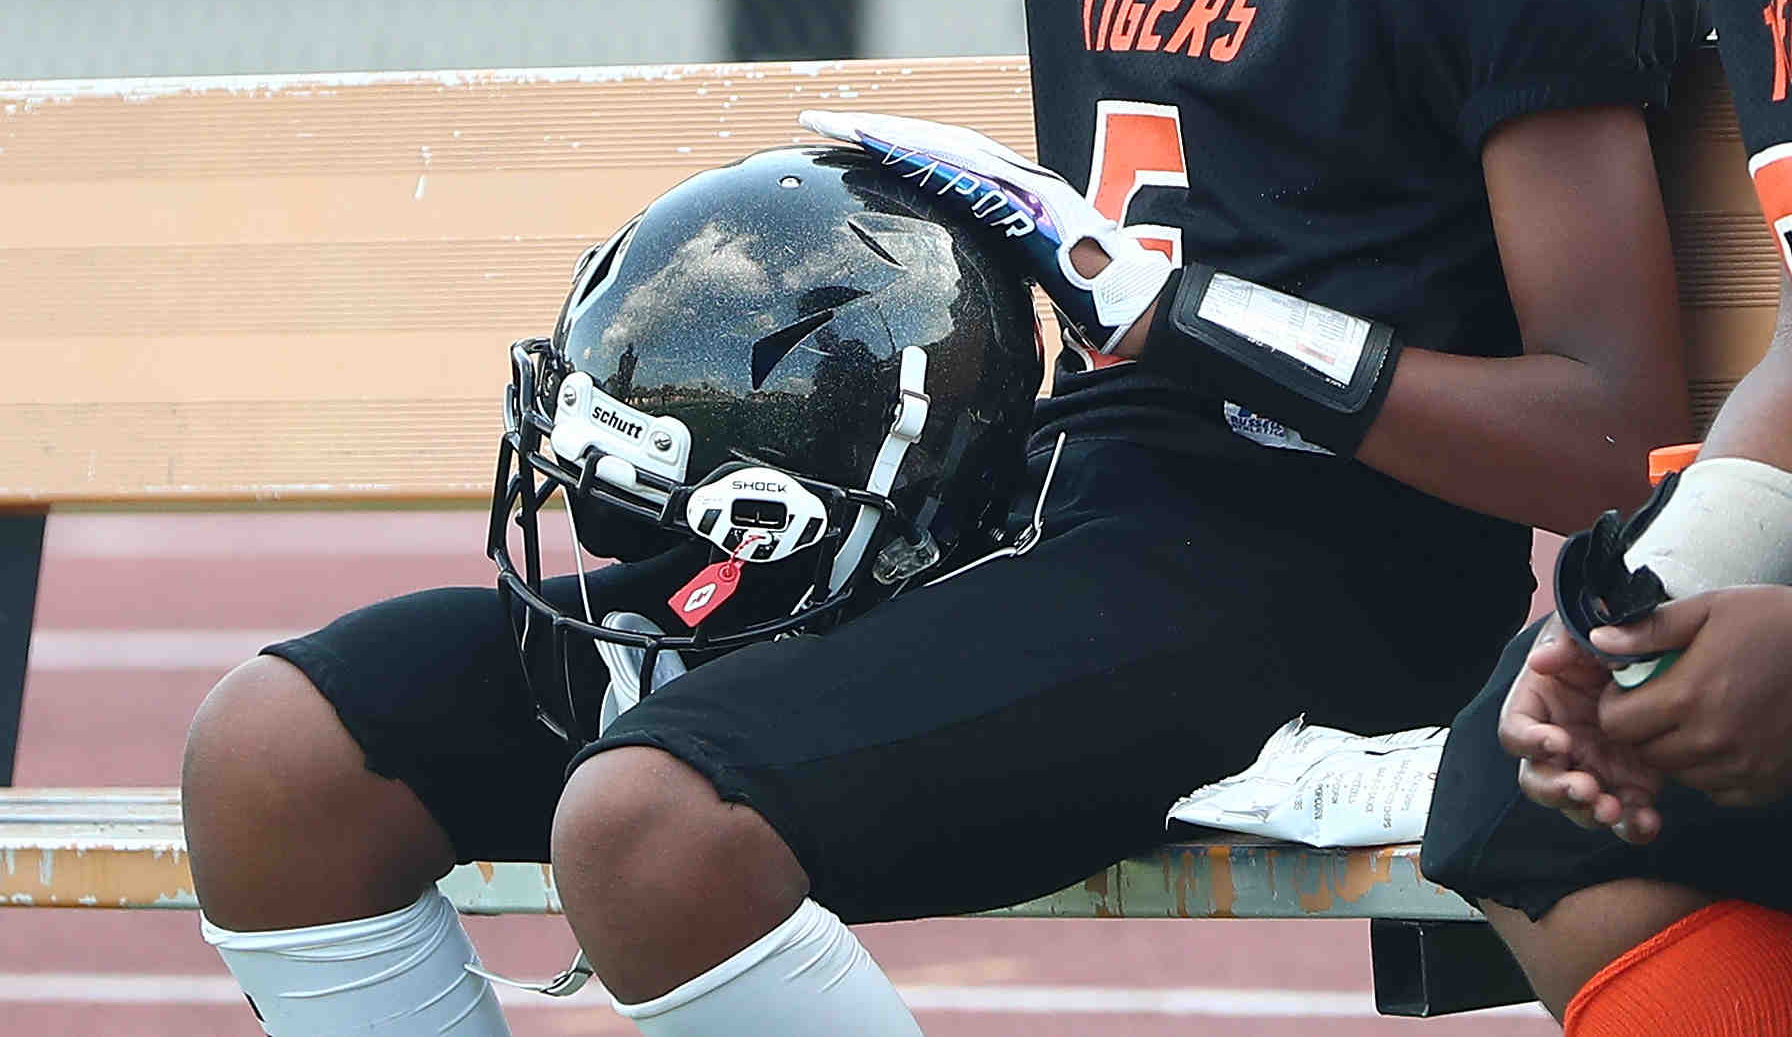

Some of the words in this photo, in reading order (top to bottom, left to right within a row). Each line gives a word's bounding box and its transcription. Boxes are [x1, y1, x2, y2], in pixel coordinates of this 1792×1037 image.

[880, 144, 1037, 239] VAPOR
[591, 403, 644, 441] schutt
[731, 479, 788, 494] SHOCK
